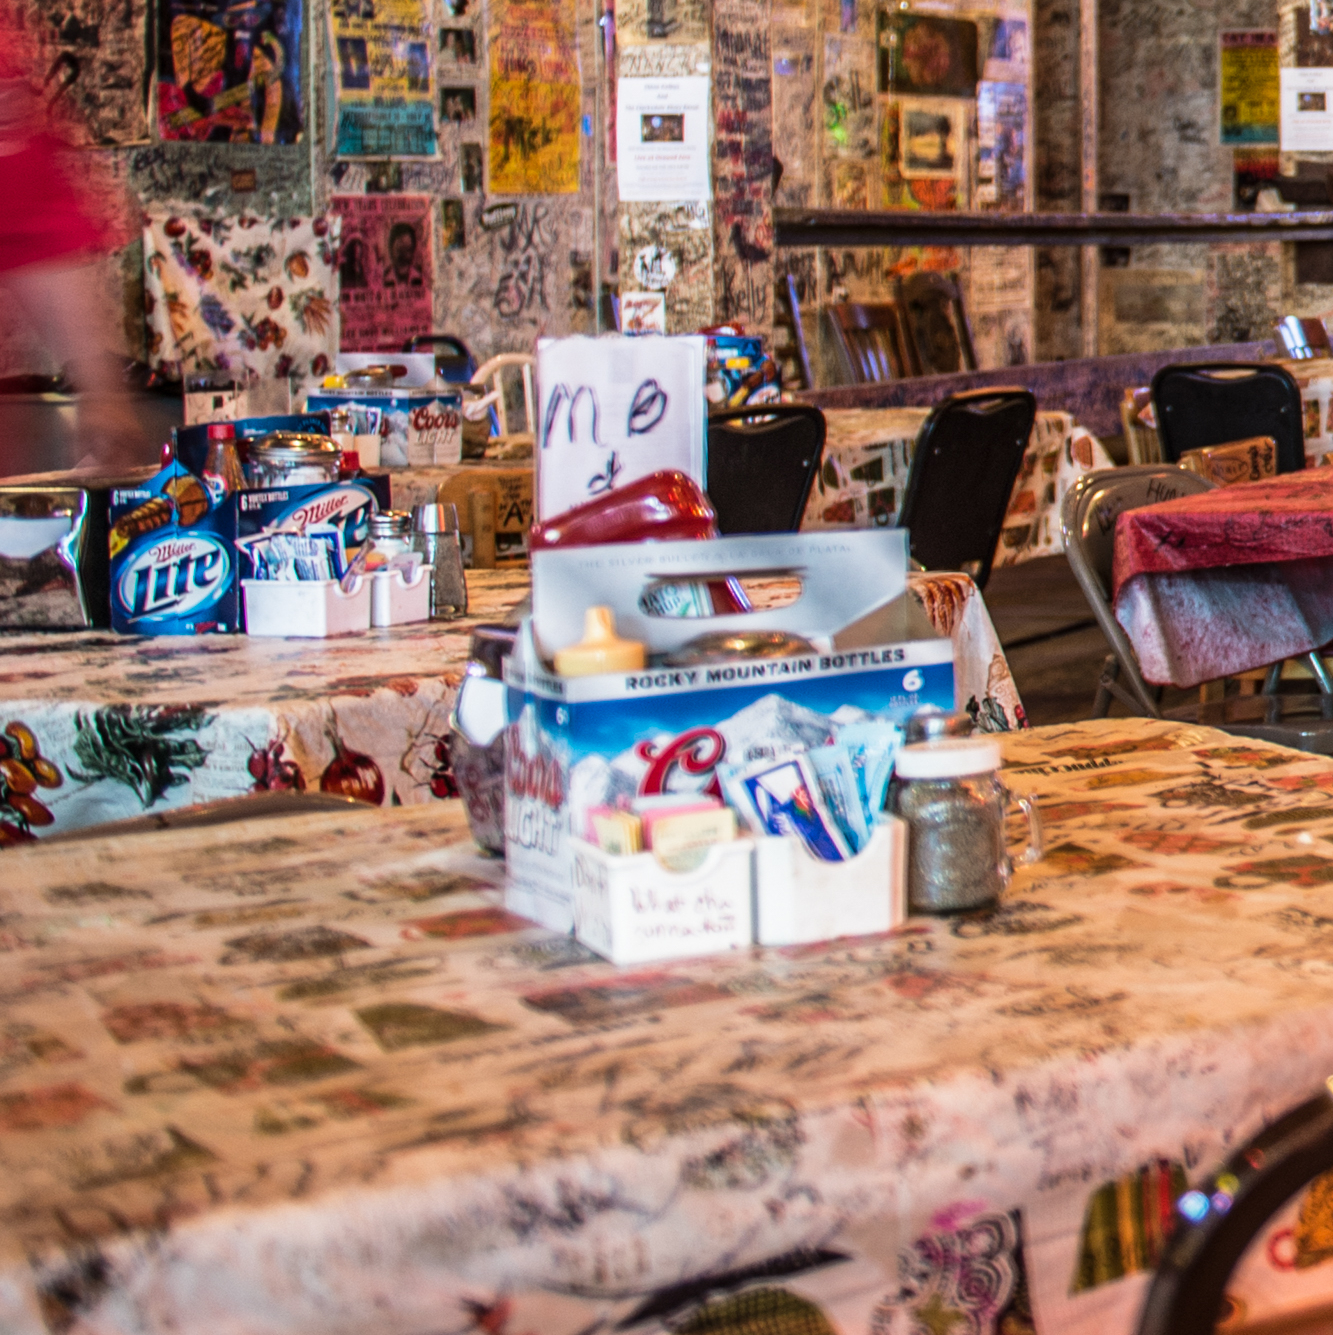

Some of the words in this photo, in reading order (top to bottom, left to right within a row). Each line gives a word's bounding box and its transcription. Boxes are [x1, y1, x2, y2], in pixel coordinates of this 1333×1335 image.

[412, 405, 459, 432] Coors
[416, 431, 454, 445] LIGHT
[292, 494, 350, 526] Miller
[148, 537, 197, 563] Miller
[608, 556, 653, 568] SILVER
[127, 551, 223, 621] Lite
[624, 669, 698, 693] ROCKY
[705, 658, 813, 685] MOUNTAIN
[818, 647, 906, 671] BOTTLES
[901, 668, 925, 694] 6
